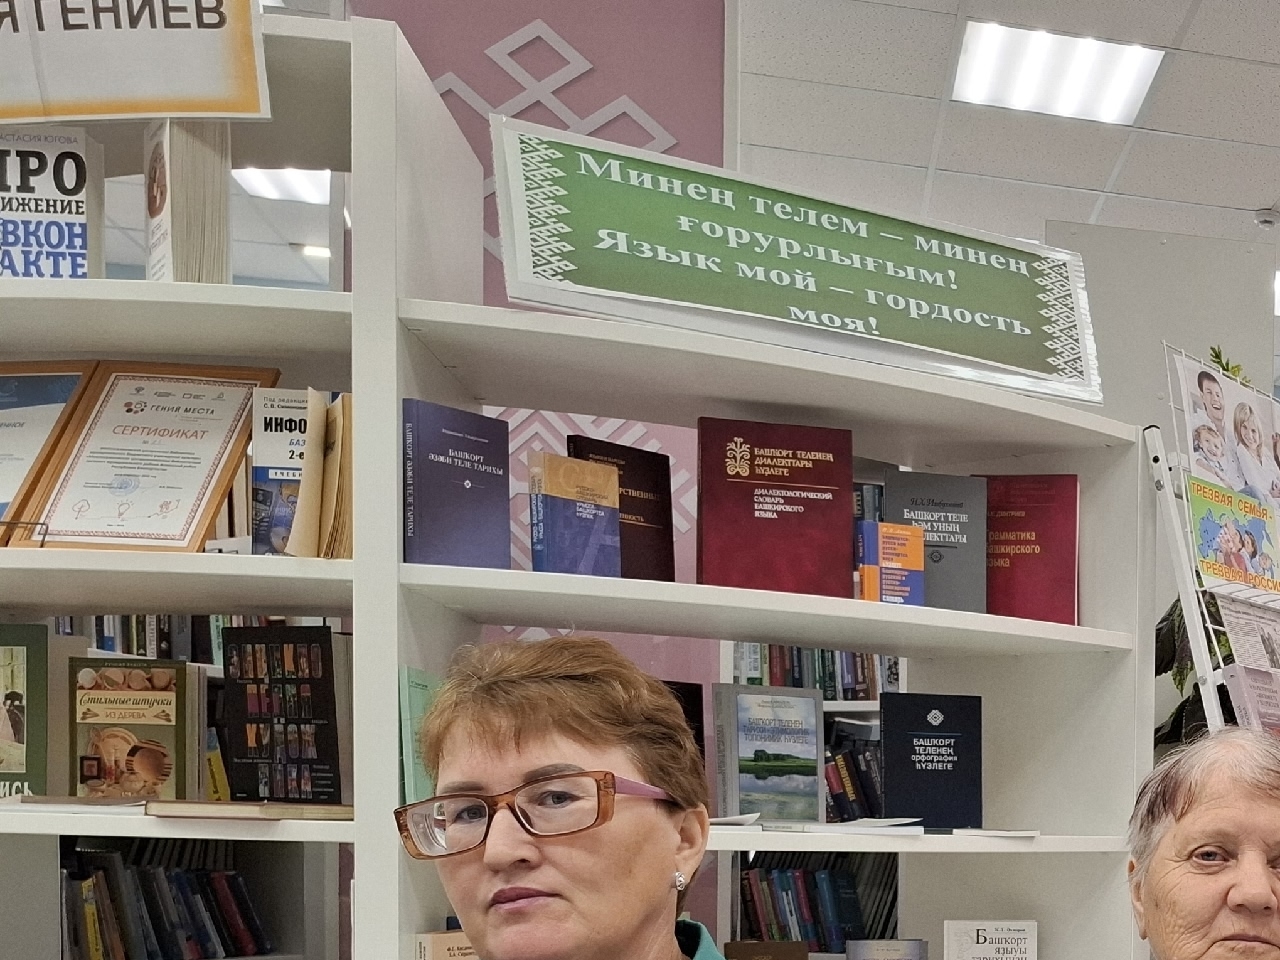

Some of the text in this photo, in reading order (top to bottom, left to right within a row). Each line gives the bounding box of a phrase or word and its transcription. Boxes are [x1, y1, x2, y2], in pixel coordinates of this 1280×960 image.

[44, 135, 78, 144] ЮГОВА
[575, 150, 735, 211] Минең
[749, 195, 869, 239] телем
[914, 232, 1031, 279] минең
[0, 219, 87, 250] ВКОН
[676, 214, 960, 290] ғорурлығым!
[0, 250, 87, 278] АКТЕ
[595, 227, 723, 273] Язык
[736, 259, 819, 294] мой
[865, 285, 1033, 337] гордость
[787, 304, 882, 336] моя!
[184, 406, 215, 415] МЕСТА
[112, 424, 208, 440] СЕРТИФИКАТ
[264, 416, 307, 434] ИНФО
[289, 450, 305, 460] 2-е
[474, 462, 503, 476] ТАРИХЫ
[1191, 482, 1233, 507] ТРЕЗВАЯ
[1237, 493, 1268, 521] СЕМЬЯ
[947, 513, 968, 522] ТЕЛЕ
[987, 530, 1036, 541] рамматика
[987, 557, 1010, 568] зыка
[1199, 559, 1244, 582] ТРЕЗВАЯ
[79, 692, 173, 709] Стильные штучки
[105, 711, 147, 720] ИЗ ДЕРЕВА
[911, 754, 958, 762] орфография
